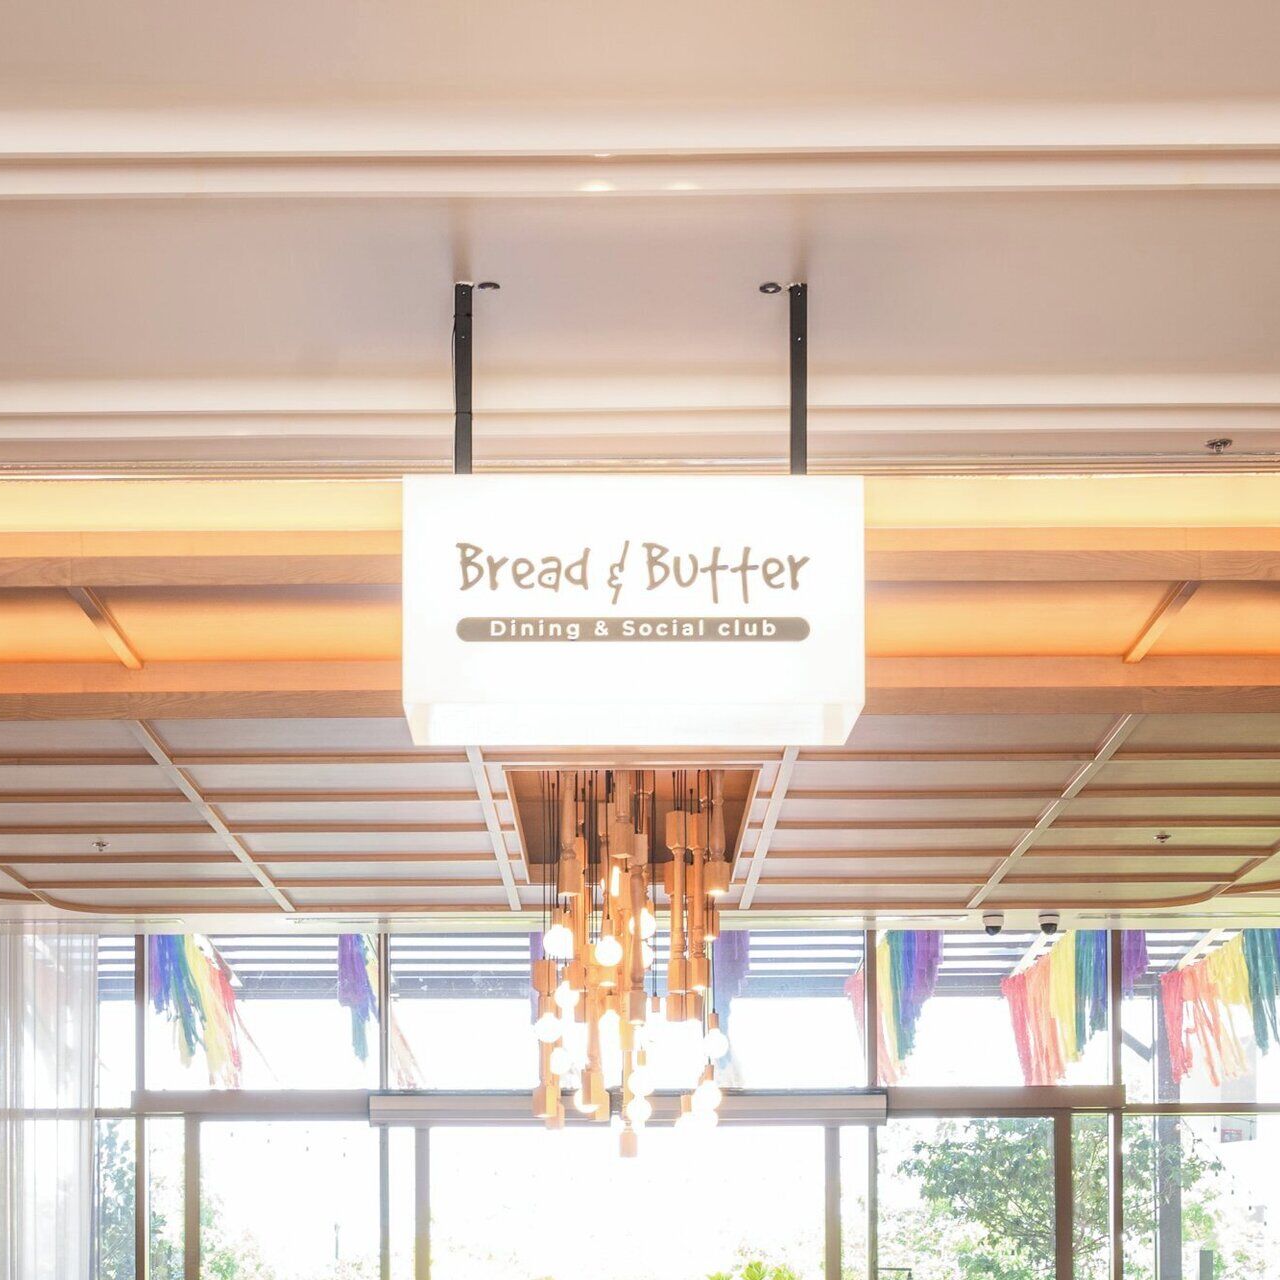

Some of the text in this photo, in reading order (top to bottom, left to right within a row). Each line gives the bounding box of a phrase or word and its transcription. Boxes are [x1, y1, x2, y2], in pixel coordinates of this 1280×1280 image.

[455, 539, 811, 605] Bread & Butter
[489, 619, 777, 640] Dining & Social club
